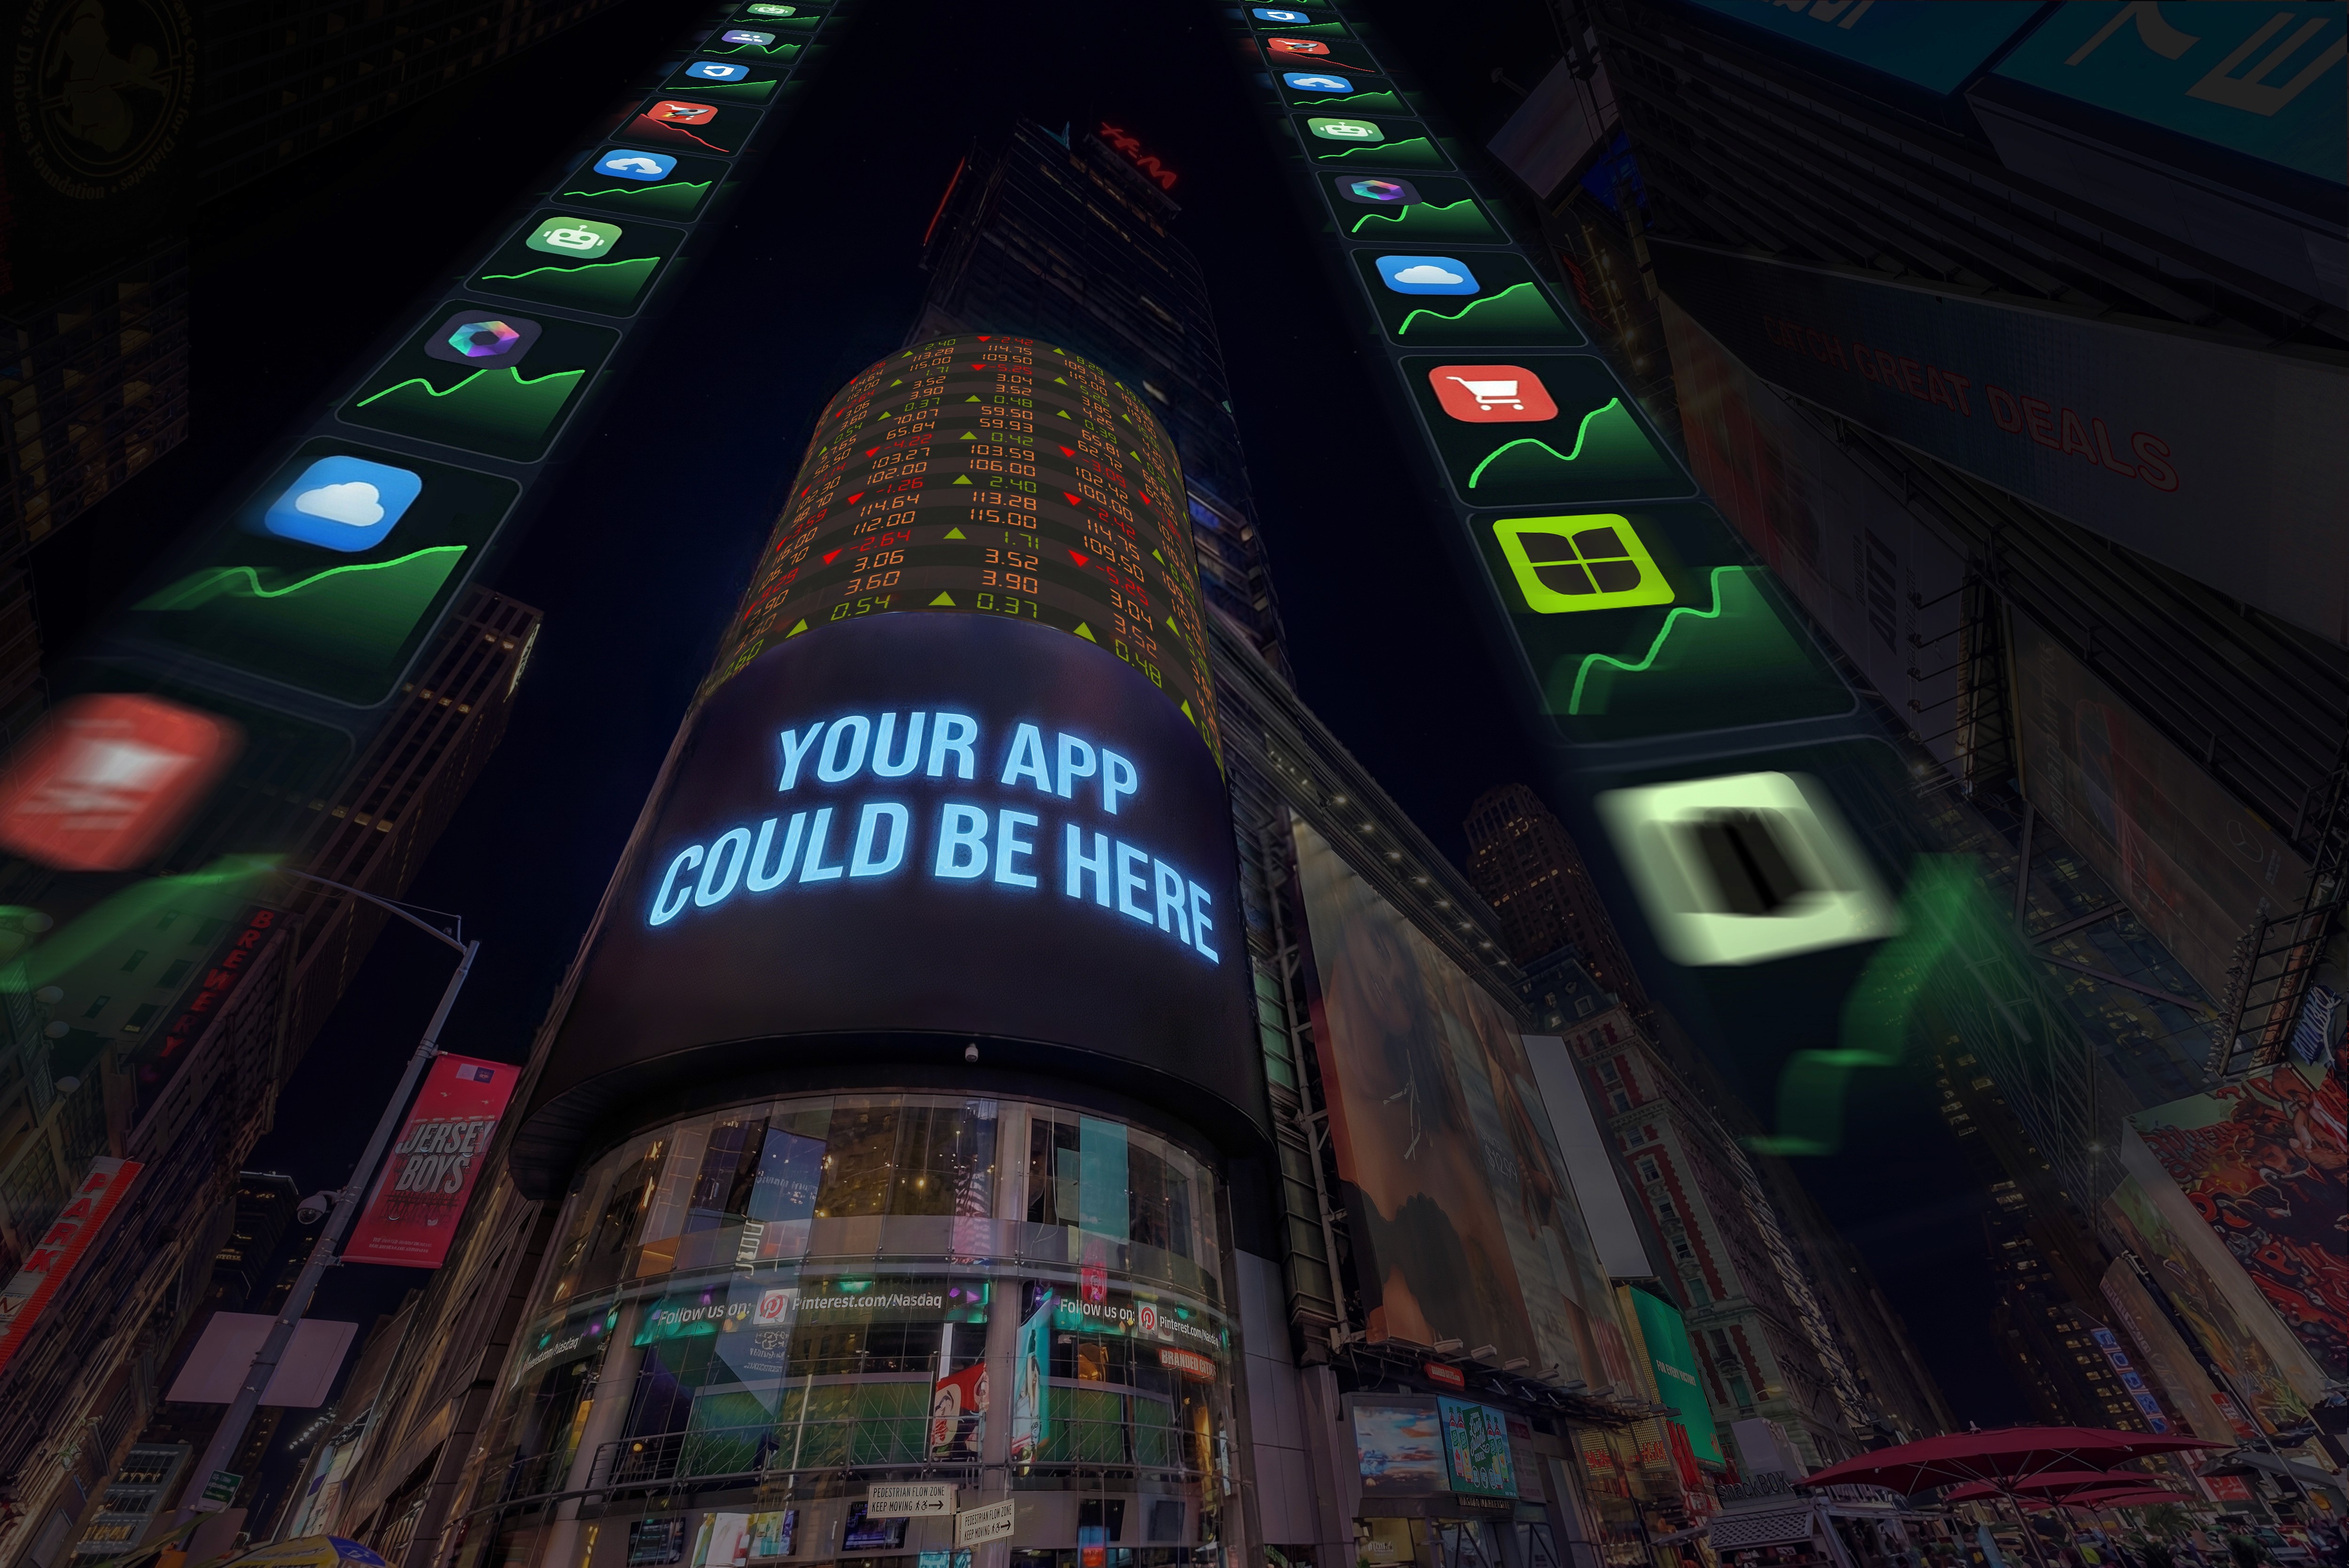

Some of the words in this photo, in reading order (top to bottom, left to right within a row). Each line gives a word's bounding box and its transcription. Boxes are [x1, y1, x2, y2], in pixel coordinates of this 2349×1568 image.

[13, 43, 34, 144] Diabetes
[26, 140, 105, 200] Foundation
[120, 135, 176, 191] Diabetes
[925, 339, 956, 350] 2.40
[988, 345, 1033, 356] 114.75
[993, 337, 1033, 346] -2.42
[910, 357, 951, 372] 115.00
[913, 348, 954, 362] 113.28
[982, 354, 1033, 365] 109.50
[1076, 356, 1104, 376] 8.29
[851, 369, 883, 391] 114.64
[926, 367, 949, 376] 1.71
[989, 364, 1033, 375] -5.25
[996, 374, 1033, 385] 3.04
[1065, 359, 1105, 386] 109.73
[847, 379, 880, 402] 112.00
[909, 387, 944, 400] 3.90
[913, 376, 946, 389] 3.52
[996, 384, 1032, 396] 3.52
[1070, 371, 1108, 396] 115.00
[842, 389, 875, 411] -2.64
[904, 397, 940, 411] 0.37
[994, 396, 1033, 407] 0.48
[1081, 385, 1110, 407] 5.26
[1082, 396, 1112, 419] 3.85
[1762, 314, 1849, 372] CATCH
[1852, 342, 1971, 417] GREAT
[1985, 383, 2180, 492] DEALS
[840, 410, 867, 432] 3.60
[844, 400, 870, 419] 3.06
[894, 409, 939, 424] 70.07
[981, 406, 1033, 419] 59.50
[1082, 407, 1114, 432] 4.25
[1121, 393, 1154, 427] 103.99
[834, 422, 863, 444] 0.54
[886, 421, 935, 440] 65.84
[980, 419, 1033, 433] 59.93
[1085, 419, 1117, 444] 0.39
[1128, 406, 1157, 439] 119.00
[885, 434, 932, 450] -4.22
[991, 432, 1034, 446] 0.42
[1082, 429, 1120, 458] 65.81
[814, 448, 852, 479] 56.50
[872, 447, 930, 469] 103.27
[971, 444, 1034, 461] 103.59
[1078, 440, 1123, 472] 62.72
[1143, 437, 1165, 467] 4.20
[1143, 448, 1166, 479] 4.50
[817, 463, 846, 484] -1.14
[867, 462, 927, 485] 102.00
[970, 459, 1035, 477] 106.00
[1082, 458, 1126, 488] -3.09
[1147, 462, 1171, 494] 0.29
[797, 476, 841, 512] 102.30
[876, 477, 924, 495] -1.26
[989, 476, 1037, 493] 2.40
[1075, 466, 1128, 503] 102.42
[1143, 469, 1174, 510] 66.85
[860, 494, 920, 517] 114.64
[972, 491, 1037, 511] 113.28
[1078, 482, 1133, 522] 100.00
[1145, 483, 1178, 526] 65.00
[853, 511, 916, 536] 112.00
[970, 508, 1037, 529] 115.00
[1088, 506, 1136, 541] -2.42
[772, 527, 818, 567] 116.00
[849, 530, 911, 552] -2.64
[1004, 531, 1039, 550] 1.71
[1087, 519, 1140, 561] 114.75
[852, 550, 905, 573] 3.06
[985, 549, 1039, 572] 3.52
[1083, 536, 1145, 582] 109.50
[1162, 540, 1194, 591] 110.00
[844, 570, 901, 596] 3.60
[981, 570, 1038, 595] 3.90
[1096, 565, 1149, 606] -5.25
[830, 594, 892, 621] 0.54
[977, 593, 1037, 619] 0.37
[1110, 589, 1154, 631] 3.04
[734, 613, 777, 656] 3.50
[1113, 613, 1158, 659] 3.52
[1172, 598, 1206, 659] 115.00
[1115, 639, 1162, 689] 0.48
[778, 712, 978, 792] YOUR
[1001, 722, 1138, 815] APP
[649, 802, 909, 926] COULD
[935, 803, 1038, 888] BE
[1066, 822, 1219, 964] HERE
[161, 910, 275, 1058] BREWERY
[395, 1120, 497, 1154] JERSEY
[395, 1154, 470, 1194] BOYS
[24, 1172, 108, 1272] PARK
[658, 1306, 705, 1326] Follow
[708, 1305, 724, 1318] us
[792, 1293, 942, 1310] Pinterest.com/Nasdaq
[1060, 1298, 1103, 1316] Follow
[1104, 1306, 1117, 1319] us
[1161, 1350, 1198, 1371] BRANDED
[1656, 1359, 1665, 1373] FOR
[873, 1487, 910, 1498] PEDESTRIAN
[912, 1487, 928, 1496] FLOW
[930, 1486, 945, 1496] ZONE
[1717, 1472, 1791, 1501] snackBOX
[871, 1502, 887, 1512] KEEP
[889, 1501, 912, 1512] MOVING
[965, 1511, 988, 1526] PEDESTRIAN
[989, 1508, 1000, 1520] FLOW
[1002, 1505, 1011, 1517] ZONE
[965, 1530, 974, 1541] KEEP
[975, 1526, 990, 1537] MOVING
